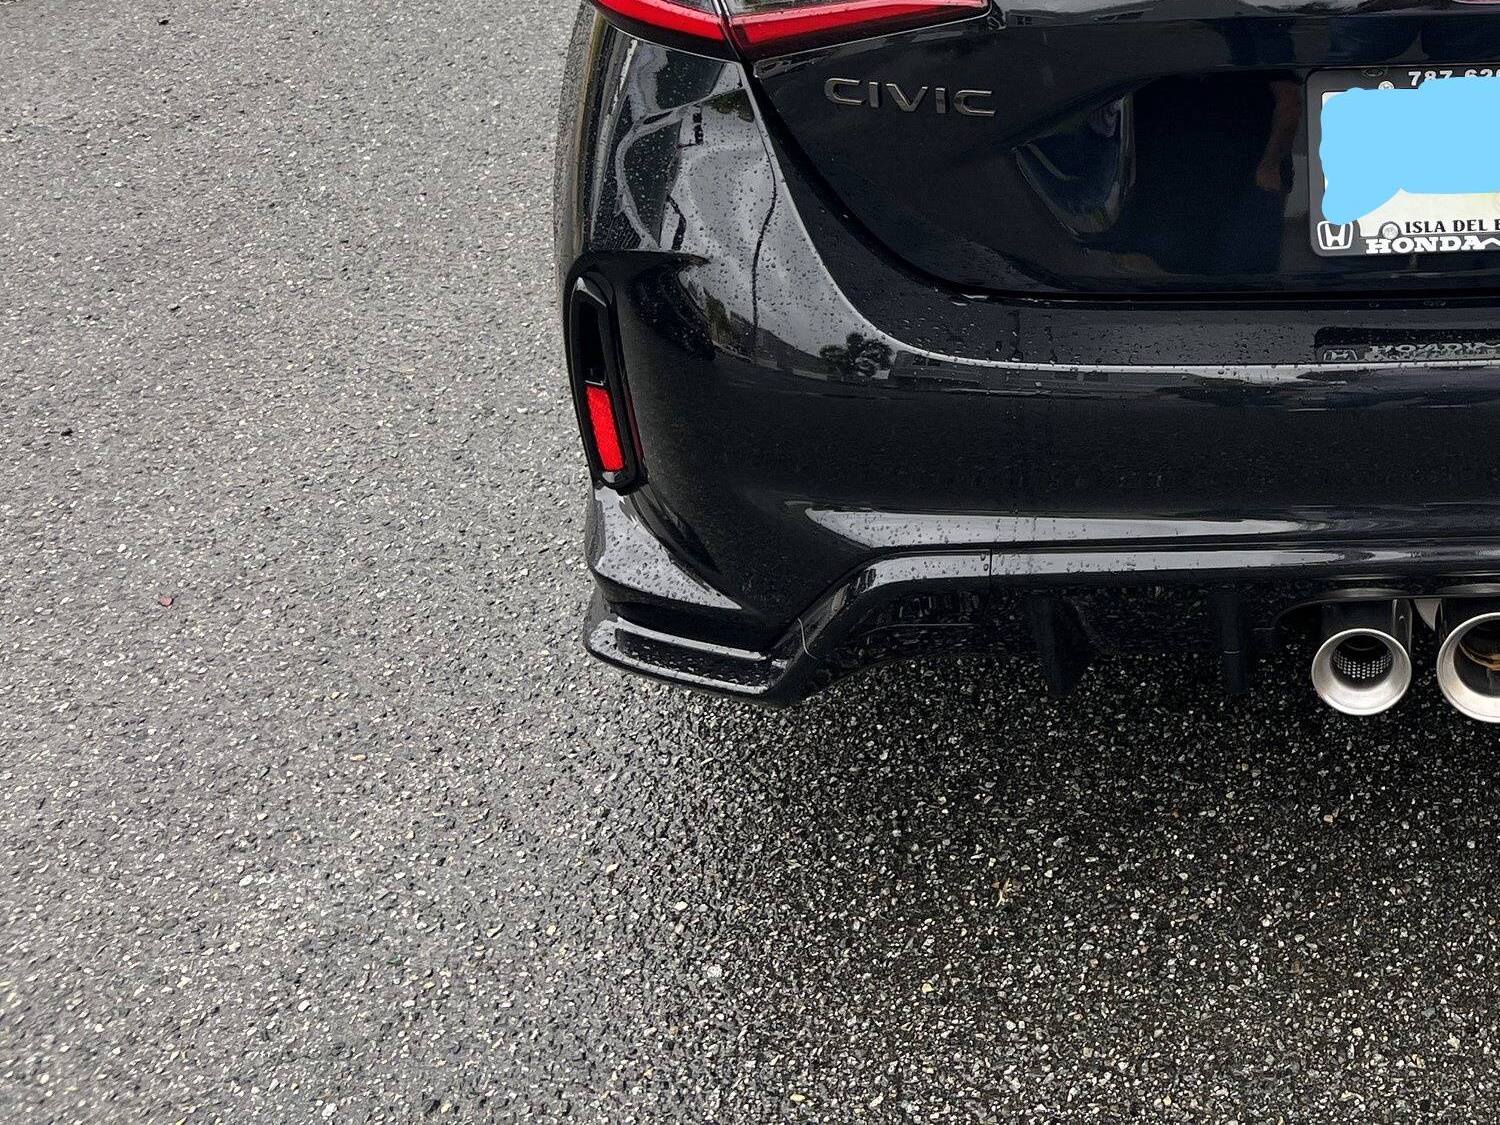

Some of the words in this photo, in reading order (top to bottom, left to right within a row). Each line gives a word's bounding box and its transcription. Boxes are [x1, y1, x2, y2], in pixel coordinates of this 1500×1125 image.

[824, 77, 996, 117] CIVIC
[1404, 220, 1446, 233] ISLA
[1453, 218, 1487, 232] DEL
[1365, 235, 1486, 254] HONDA
